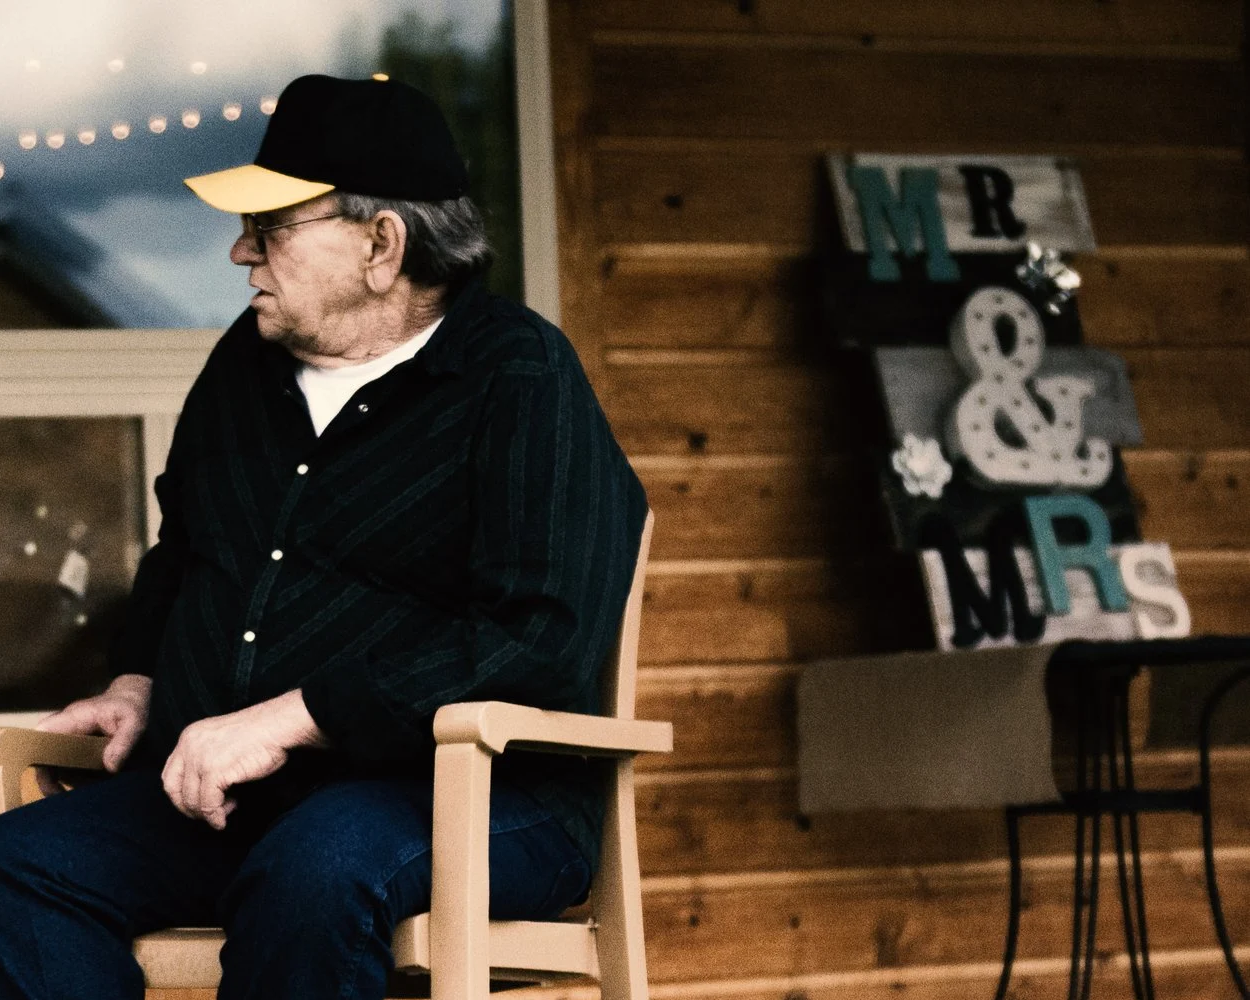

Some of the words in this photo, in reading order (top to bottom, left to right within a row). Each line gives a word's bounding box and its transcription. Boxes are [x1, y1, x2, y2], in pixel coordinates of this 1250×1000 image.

[847, 165, 1026, 281] MR
[952, 286, 1113, 489] &
[918, 495, 1192, 647] MRS
